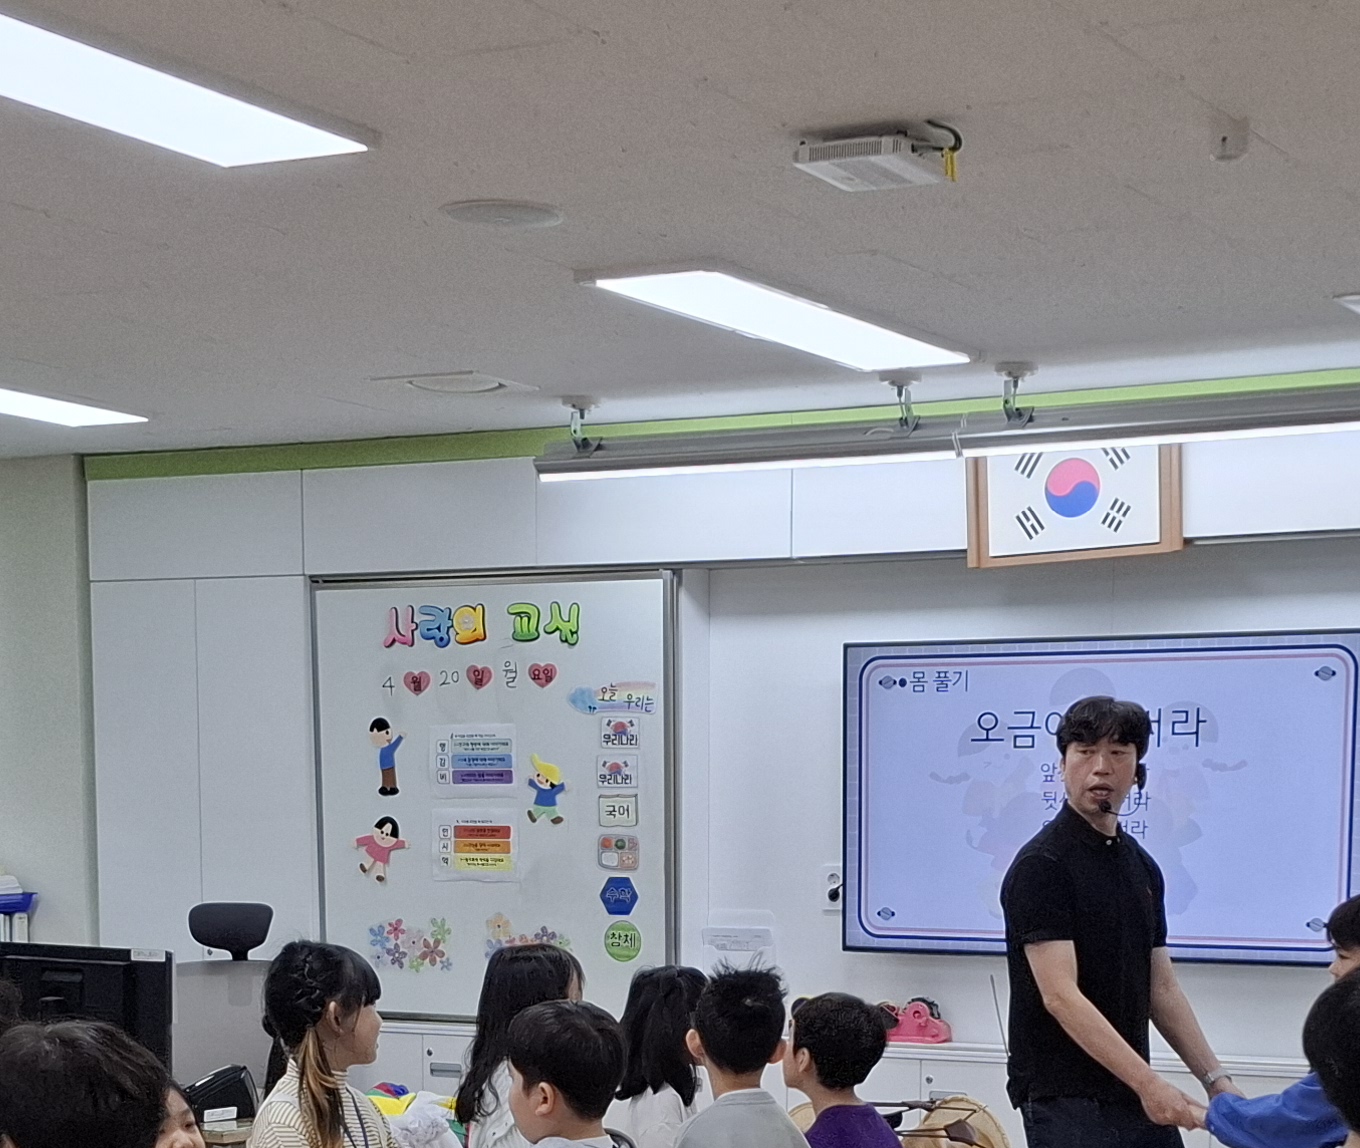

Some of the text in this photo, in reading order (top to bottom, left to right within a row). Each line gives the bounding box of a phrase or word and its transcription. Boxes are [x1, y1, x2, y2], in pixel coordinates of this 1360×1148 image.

[383, 601, 580, 648] 사랑의 교실
[382, 661, 553, 696] 4 월 20 일 월 요일
[910, 669, 970, 692] 몸 풀기
[598, 682, 654, 712] 오늘 우리는
[603, 733, 638, 746] 우리나라
[599, 774, 632, 786] 우리나라
[605, 804, 630, 819] 국어
[605, 887, 633, 903] 수학
